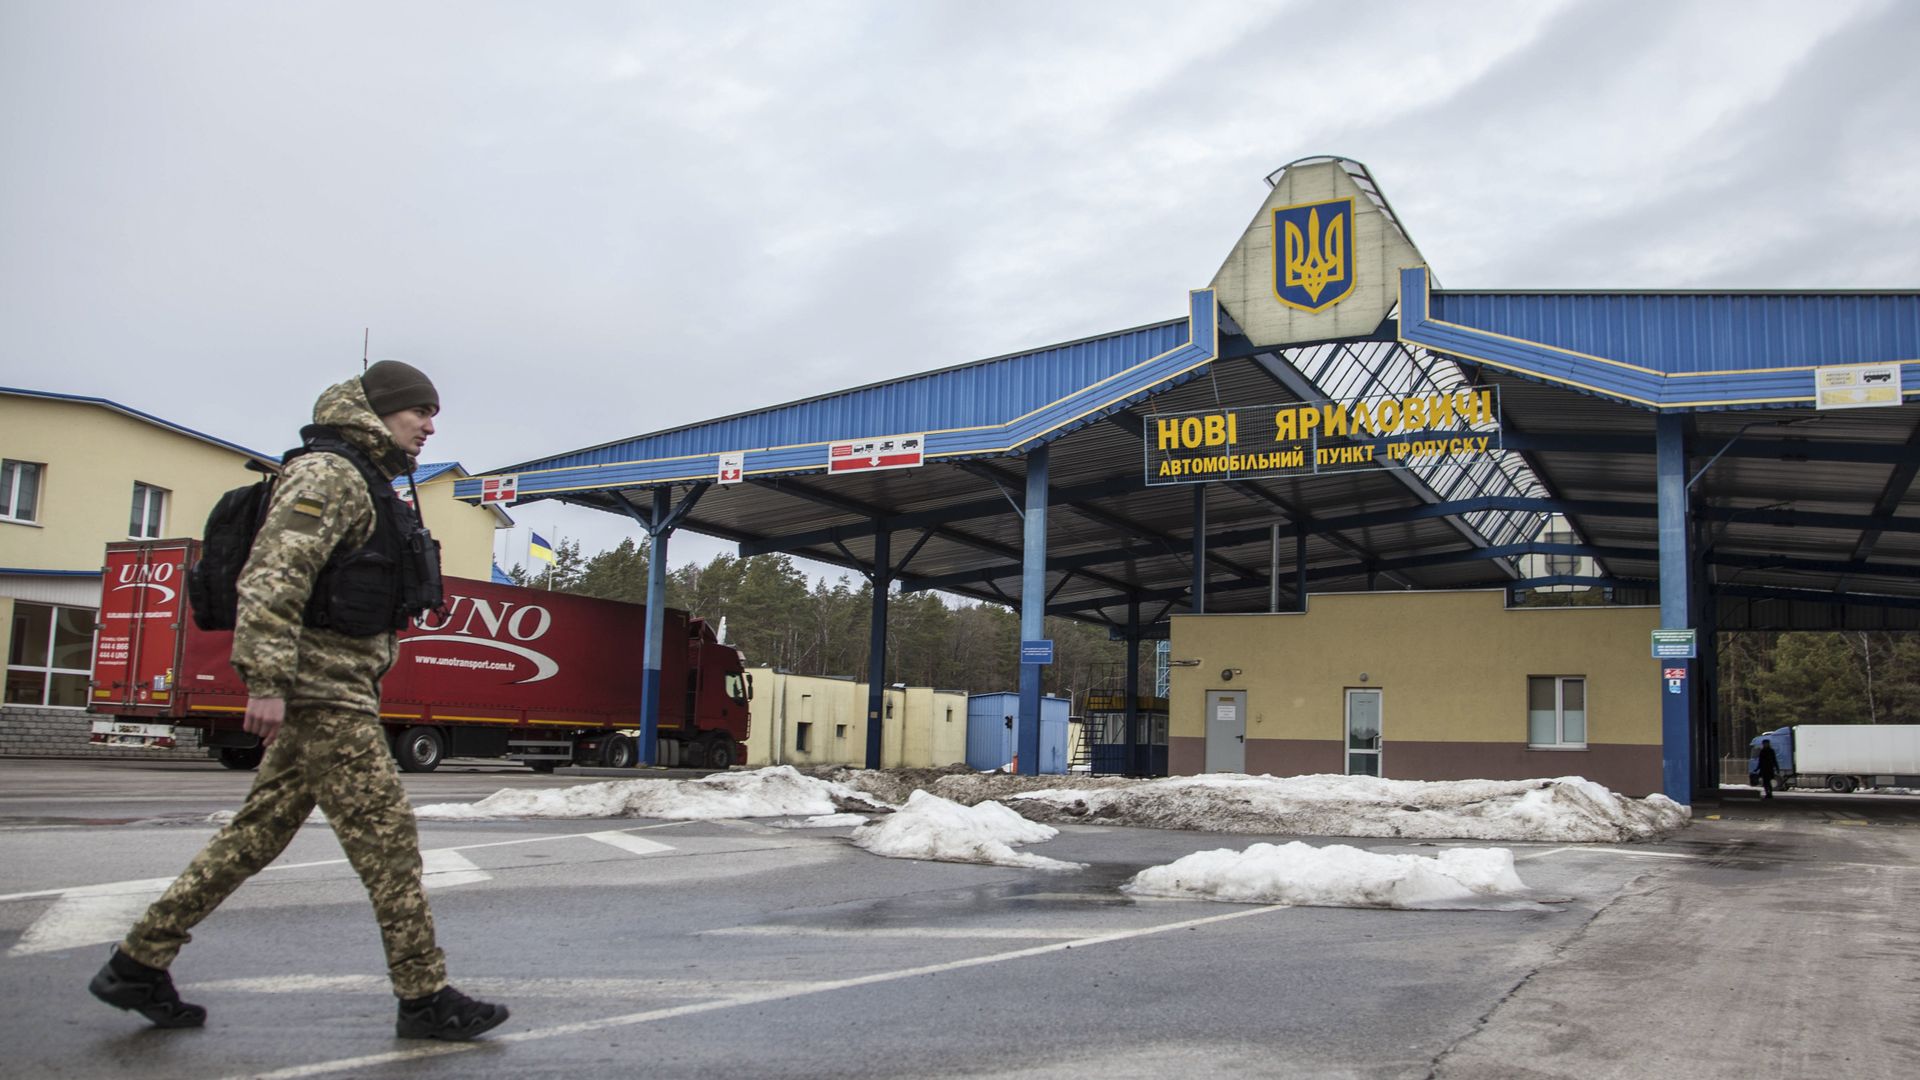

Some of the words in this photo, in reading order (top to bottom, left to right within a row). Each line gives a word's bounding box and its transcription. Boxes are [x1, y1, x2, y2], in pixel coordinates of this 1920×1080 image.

[1157, 413, 1237, 450] НОВІ
[1275, 390, 1491, 441] ЯРИЛОВИЧІ
[1159, 445, 1304, 476] АВТОМОБІЛЬНИЙ
[1316, 445, 1375, 465] ПУНКТ
[1387, 437, 1489, 460] ПРОПУСКУ
[119, 562, 174, 583] UNO
[412, 595, 551, 641] UNO
[415, 655, 515, 671] www.unotransport.com.tr
